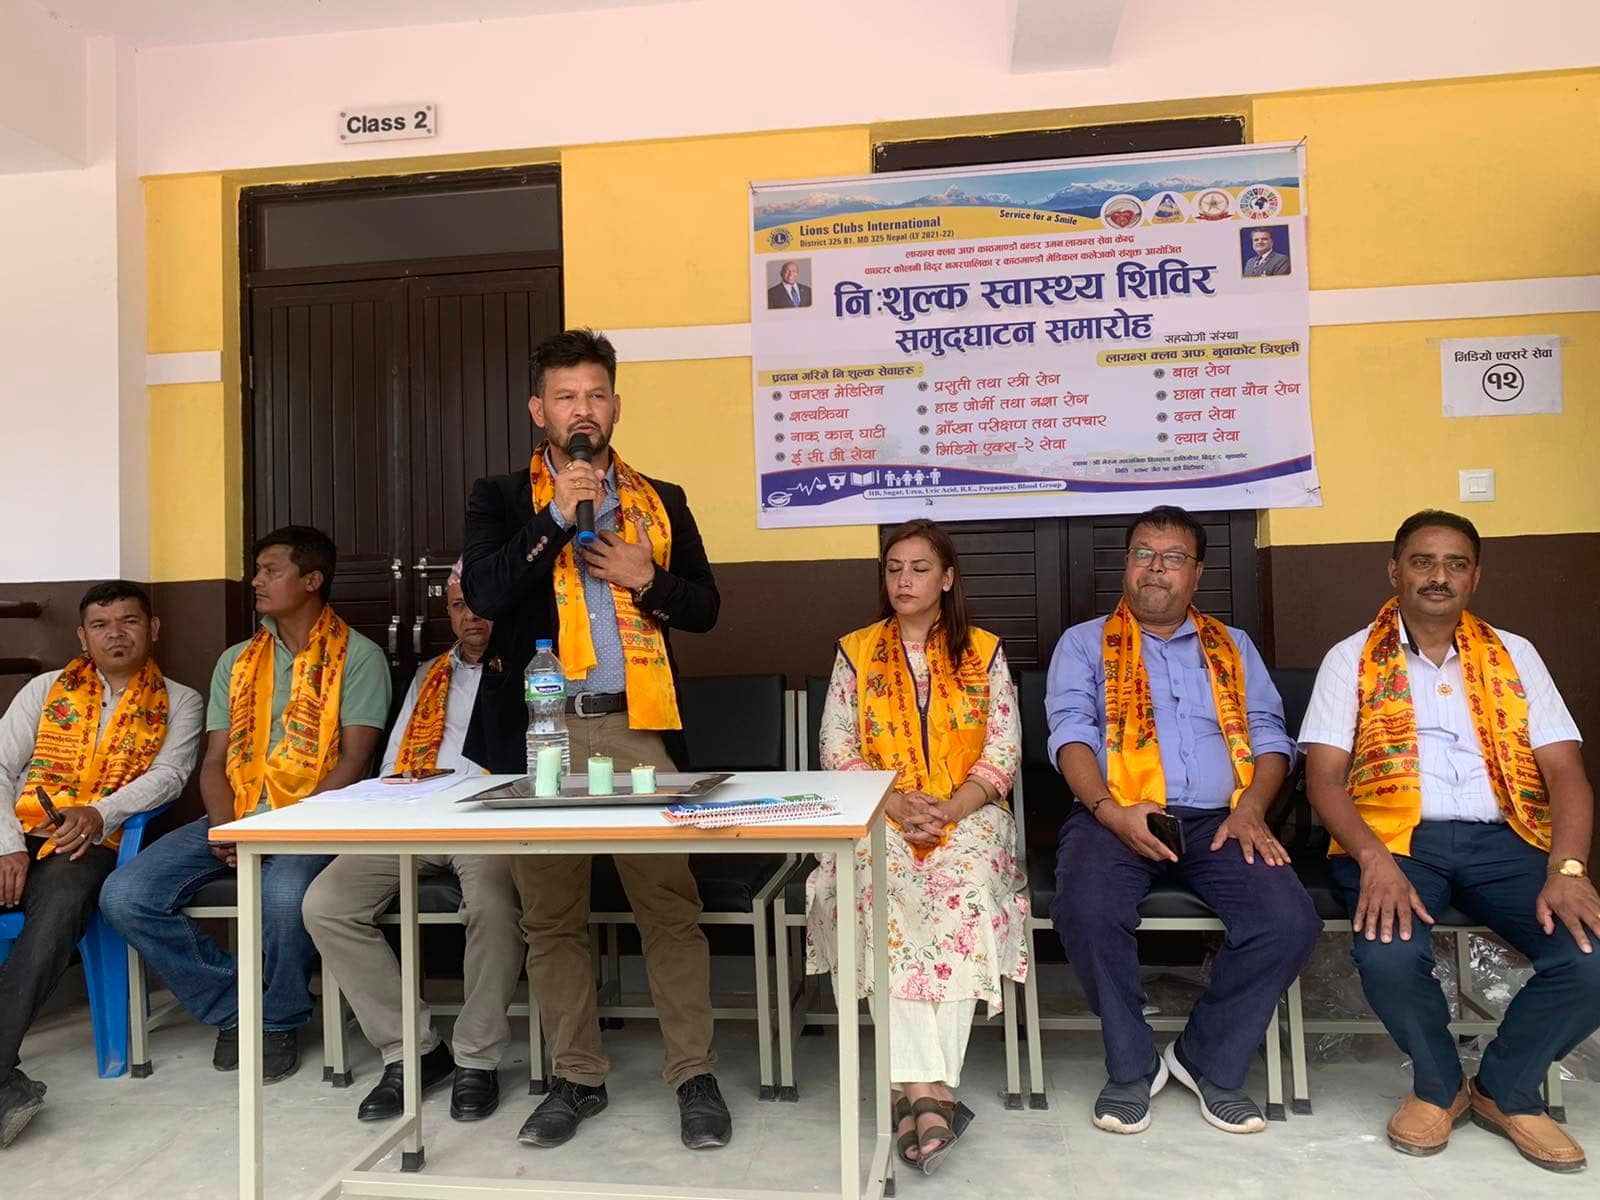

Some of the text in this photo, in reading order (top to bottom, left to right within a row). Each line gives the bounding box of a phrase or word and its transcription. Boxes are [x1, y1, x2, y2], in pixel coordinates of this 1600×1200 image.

[346, 110, 427, 134] Class 2
[800, 216, 941, 236] Lions Clubs International
[999, 209, 1031, 219] Service
[1033, 211, 1045, 221] for
[1054, 214, 1078, 225] Smile
[800, 239, 827, 248] District
[871, 235, 885, 243] 325
[886, 233, 908, 243] Nepal
[921, 230, 955, 240] 2021-22)
[981, 273, 1105, 308] स्वास्थ्य
[1116, 259, 1217, 299] शिविर
[1046, 308, 1153, 343] समारोह
[1210, 328, 1239, 341] संस्था
[1106, 351, 1147, 364] लायन्स
[1212, 343, 1256, 359] नुवाकोट
[1260, 341, 1299, 356] त्रिशुली
[1532, 347, 1553, 359] सेवा
[772, 372, 798, 384] प्रदान
[802, 369, 830, 382] गरिने
[1172, 361, 1232, 379] बाल रोग
[934, 371, 1061, 395] प्रसुती तथा स्त्री रोग
[1487, 371, 1519, 390] १२
[789, 383, 885, 401] जनरल मेडिसिन
[1173, 380, 1301, 401] छाला तथा यौन रोग
[934, 391, 1089, 415] हाड जोर्नी तथा नशा रोग
[789, 406, 850, 423] शल्यक्रिया
[1174, 406, 1237, 423] दन्त सेवा
[859, 425, 886, 440] घाटी
[978, 417, 1027, 434] परीक्षण
[1032, 417, 1057, 430] तथा
[1062, 414, 1107, 428] उपचार
[1212, 428, 1241, 444] सेवा
[851, 447, 877, 461] सेवा
[936, 440, 977, 457] भिडियो
[1039, 436, 1067, 450] सेवा
[1017, 482, 1037, 490] Blood
[1038, 481, 1062, 491] Group
